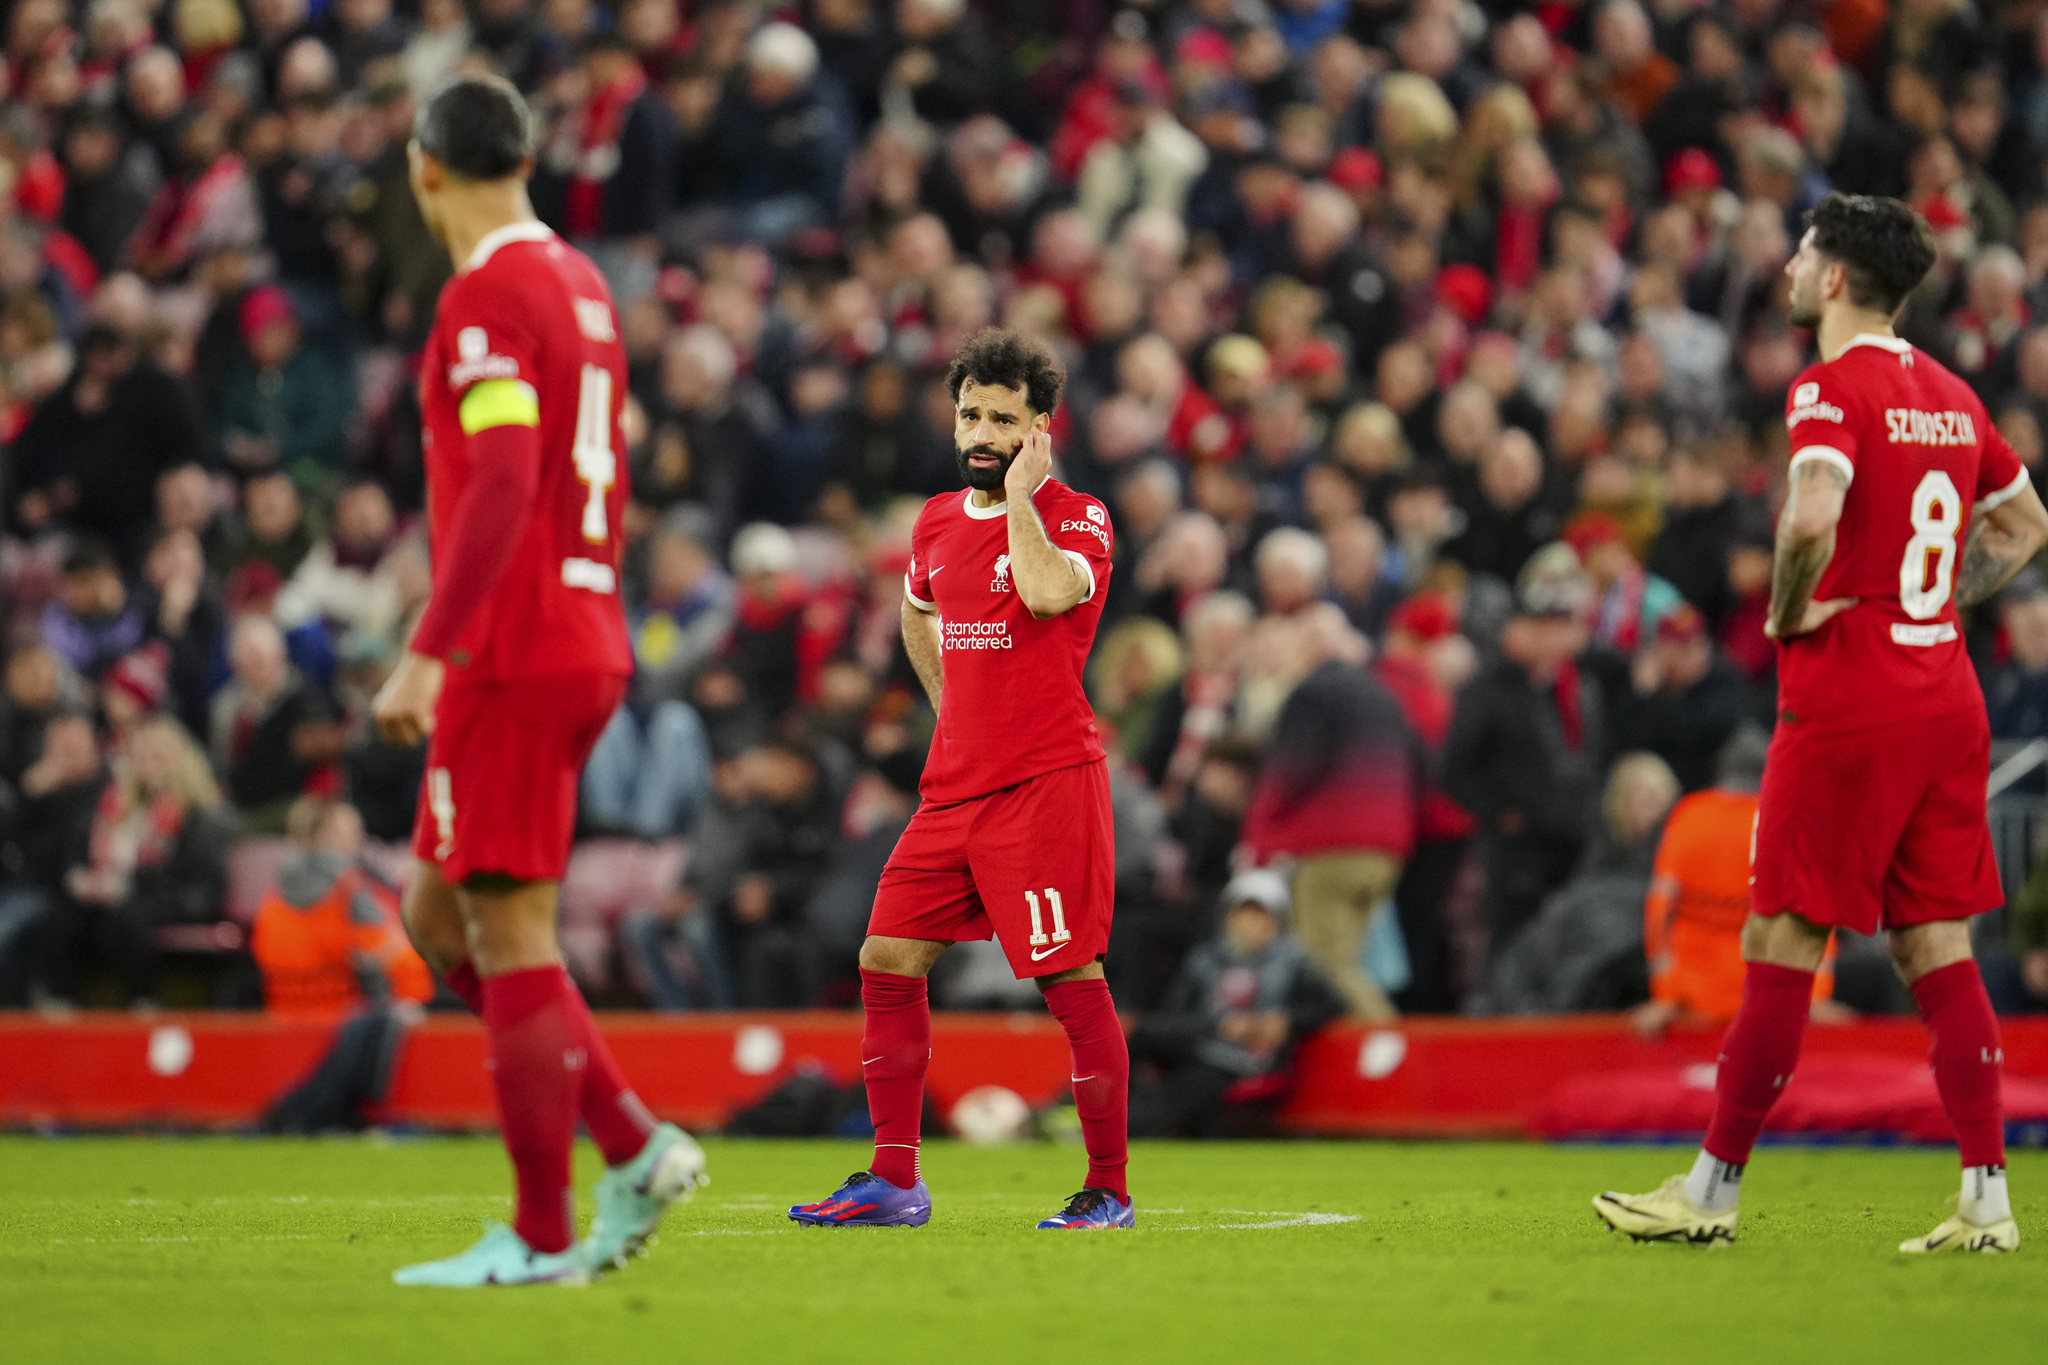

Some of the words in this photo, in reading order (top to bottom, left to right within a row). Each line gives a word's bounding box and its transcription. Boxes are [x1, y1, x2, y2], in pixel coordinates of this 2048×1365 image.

[571, 362, 616, 545] 4
[1900, 469, 1963, 620] 8
[945, 619, 1007, 636] standard
[945, 634, 1013, 650] chartered
[1024, 887, 1072, 946] 11
